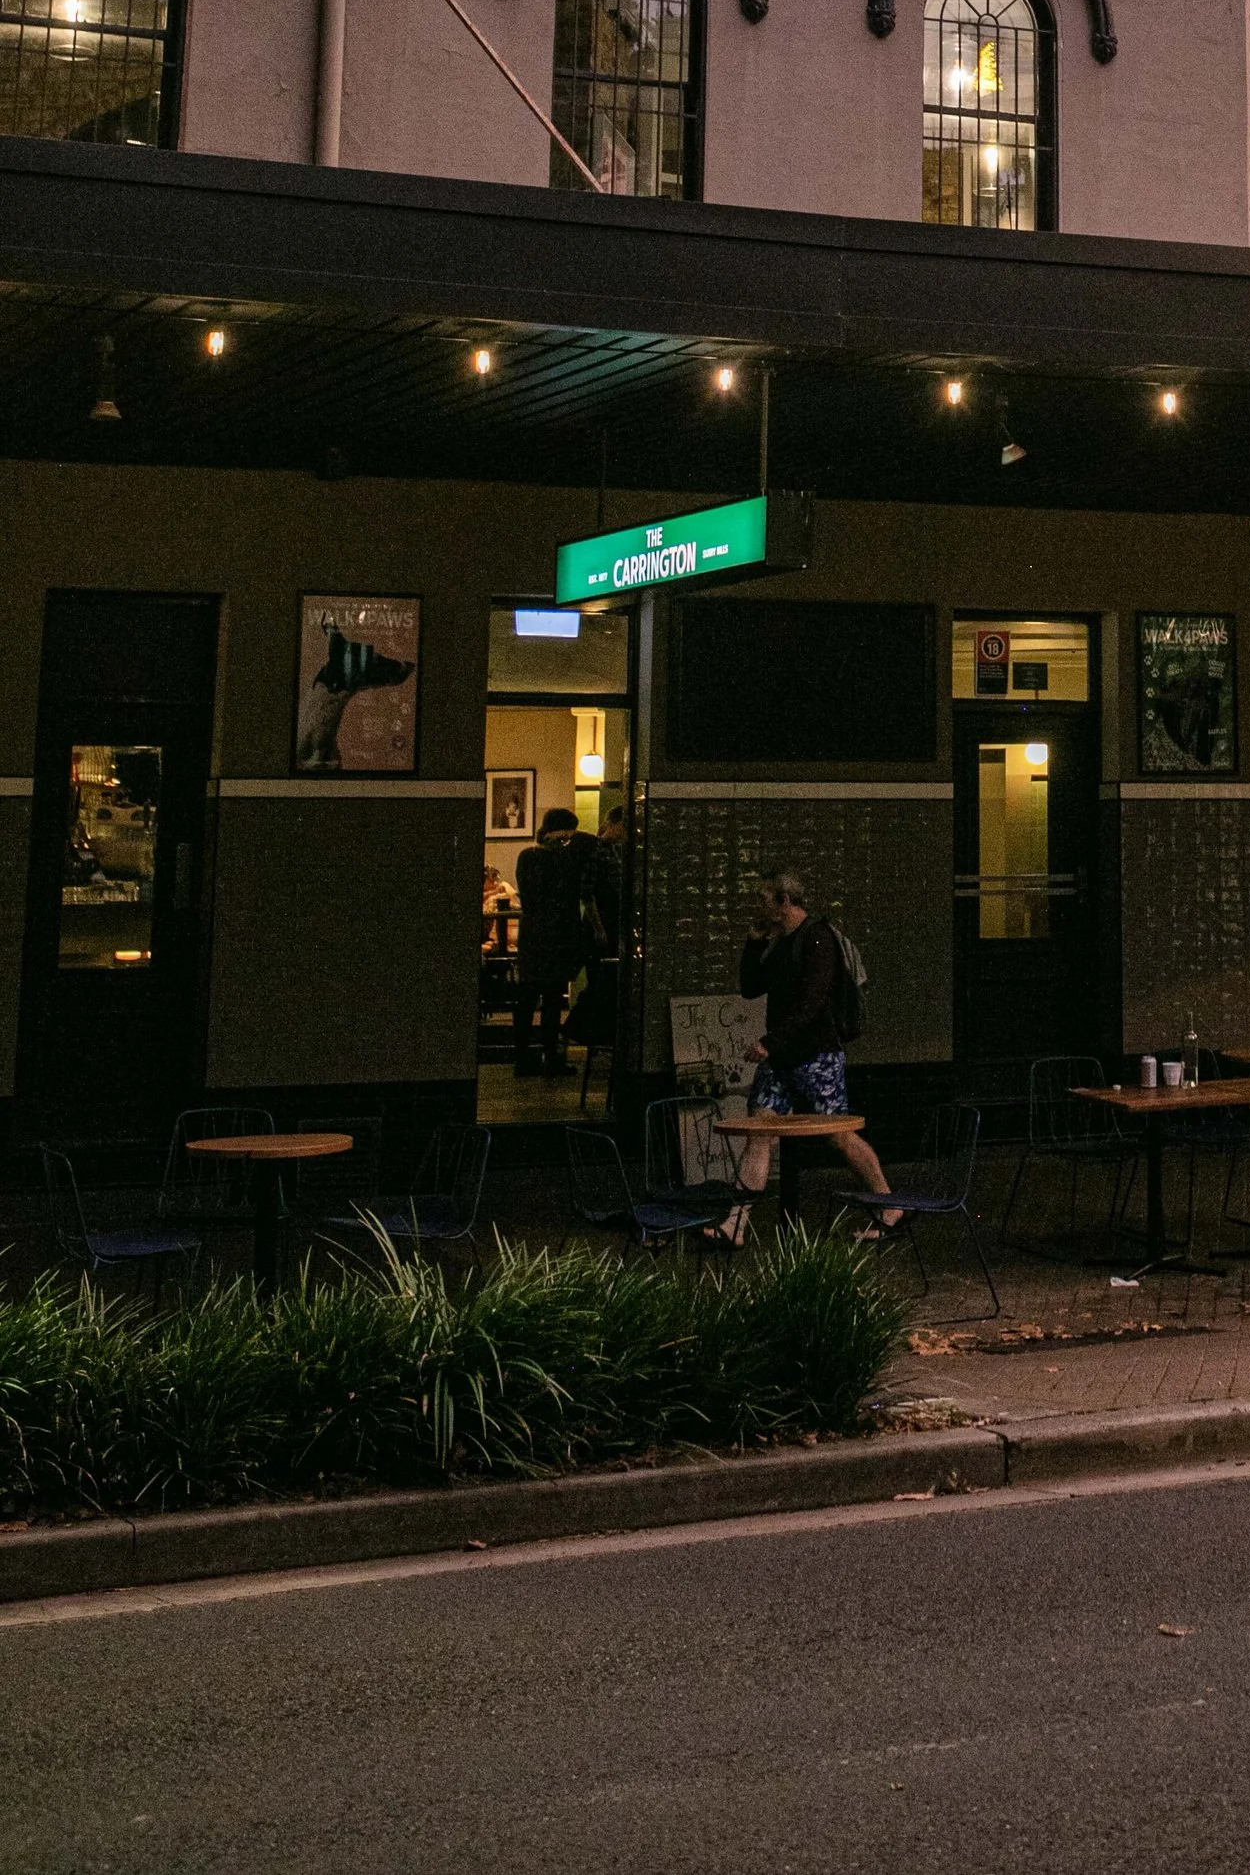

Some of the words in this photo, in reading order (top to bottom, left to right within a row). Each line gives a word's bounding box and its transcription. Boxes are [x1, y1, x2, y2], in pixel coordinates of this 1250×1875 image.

[645, 527, 663, 548] THE
[613, 541, 697, 588] CARRINGTON
[987, 643, 999, 656] 18
